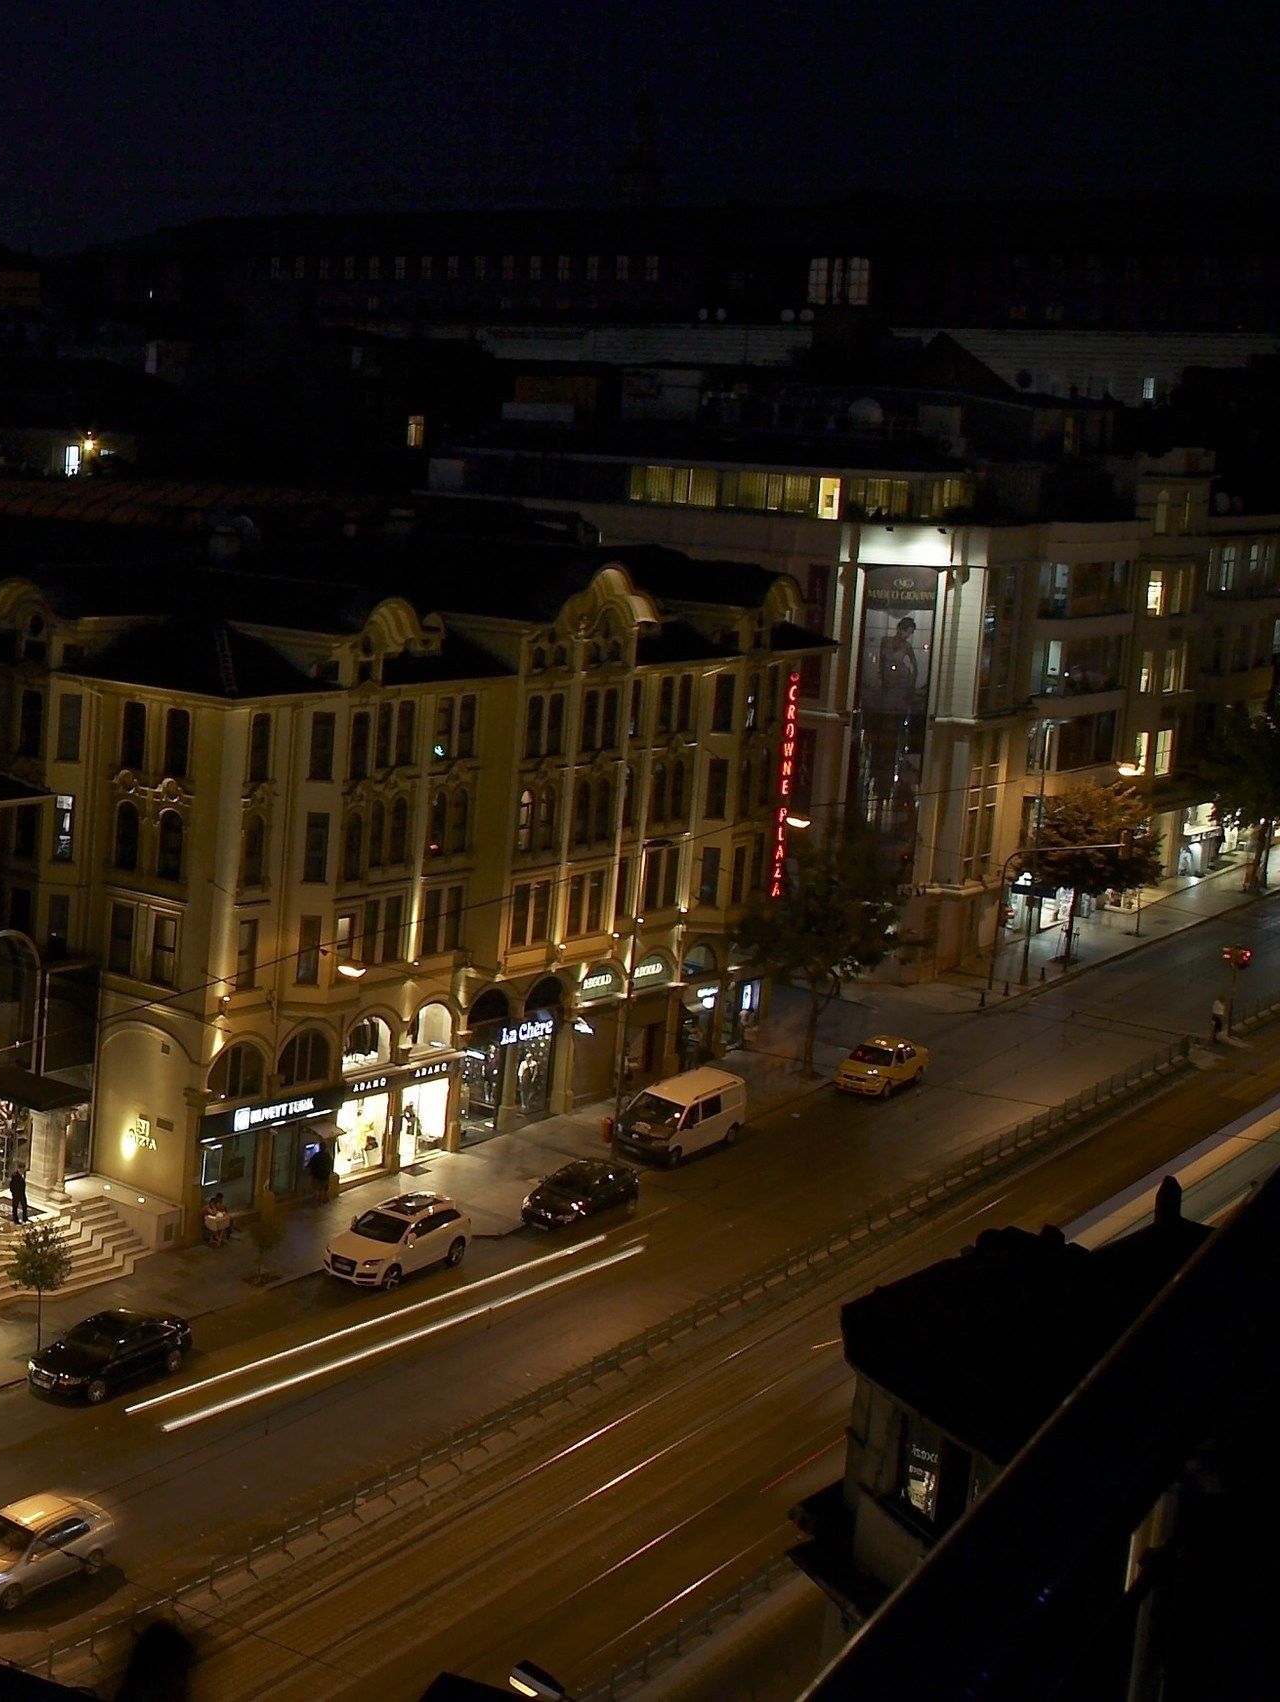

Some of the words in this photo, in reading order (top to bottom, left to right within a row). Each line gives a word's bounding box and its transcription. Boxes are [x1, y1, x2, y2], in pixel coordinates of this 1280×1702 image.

[780, 685, 798, 795] CROWNE
[771, 807, 787, 898] PLAZA
[500, 1027, 518, 1046] La
